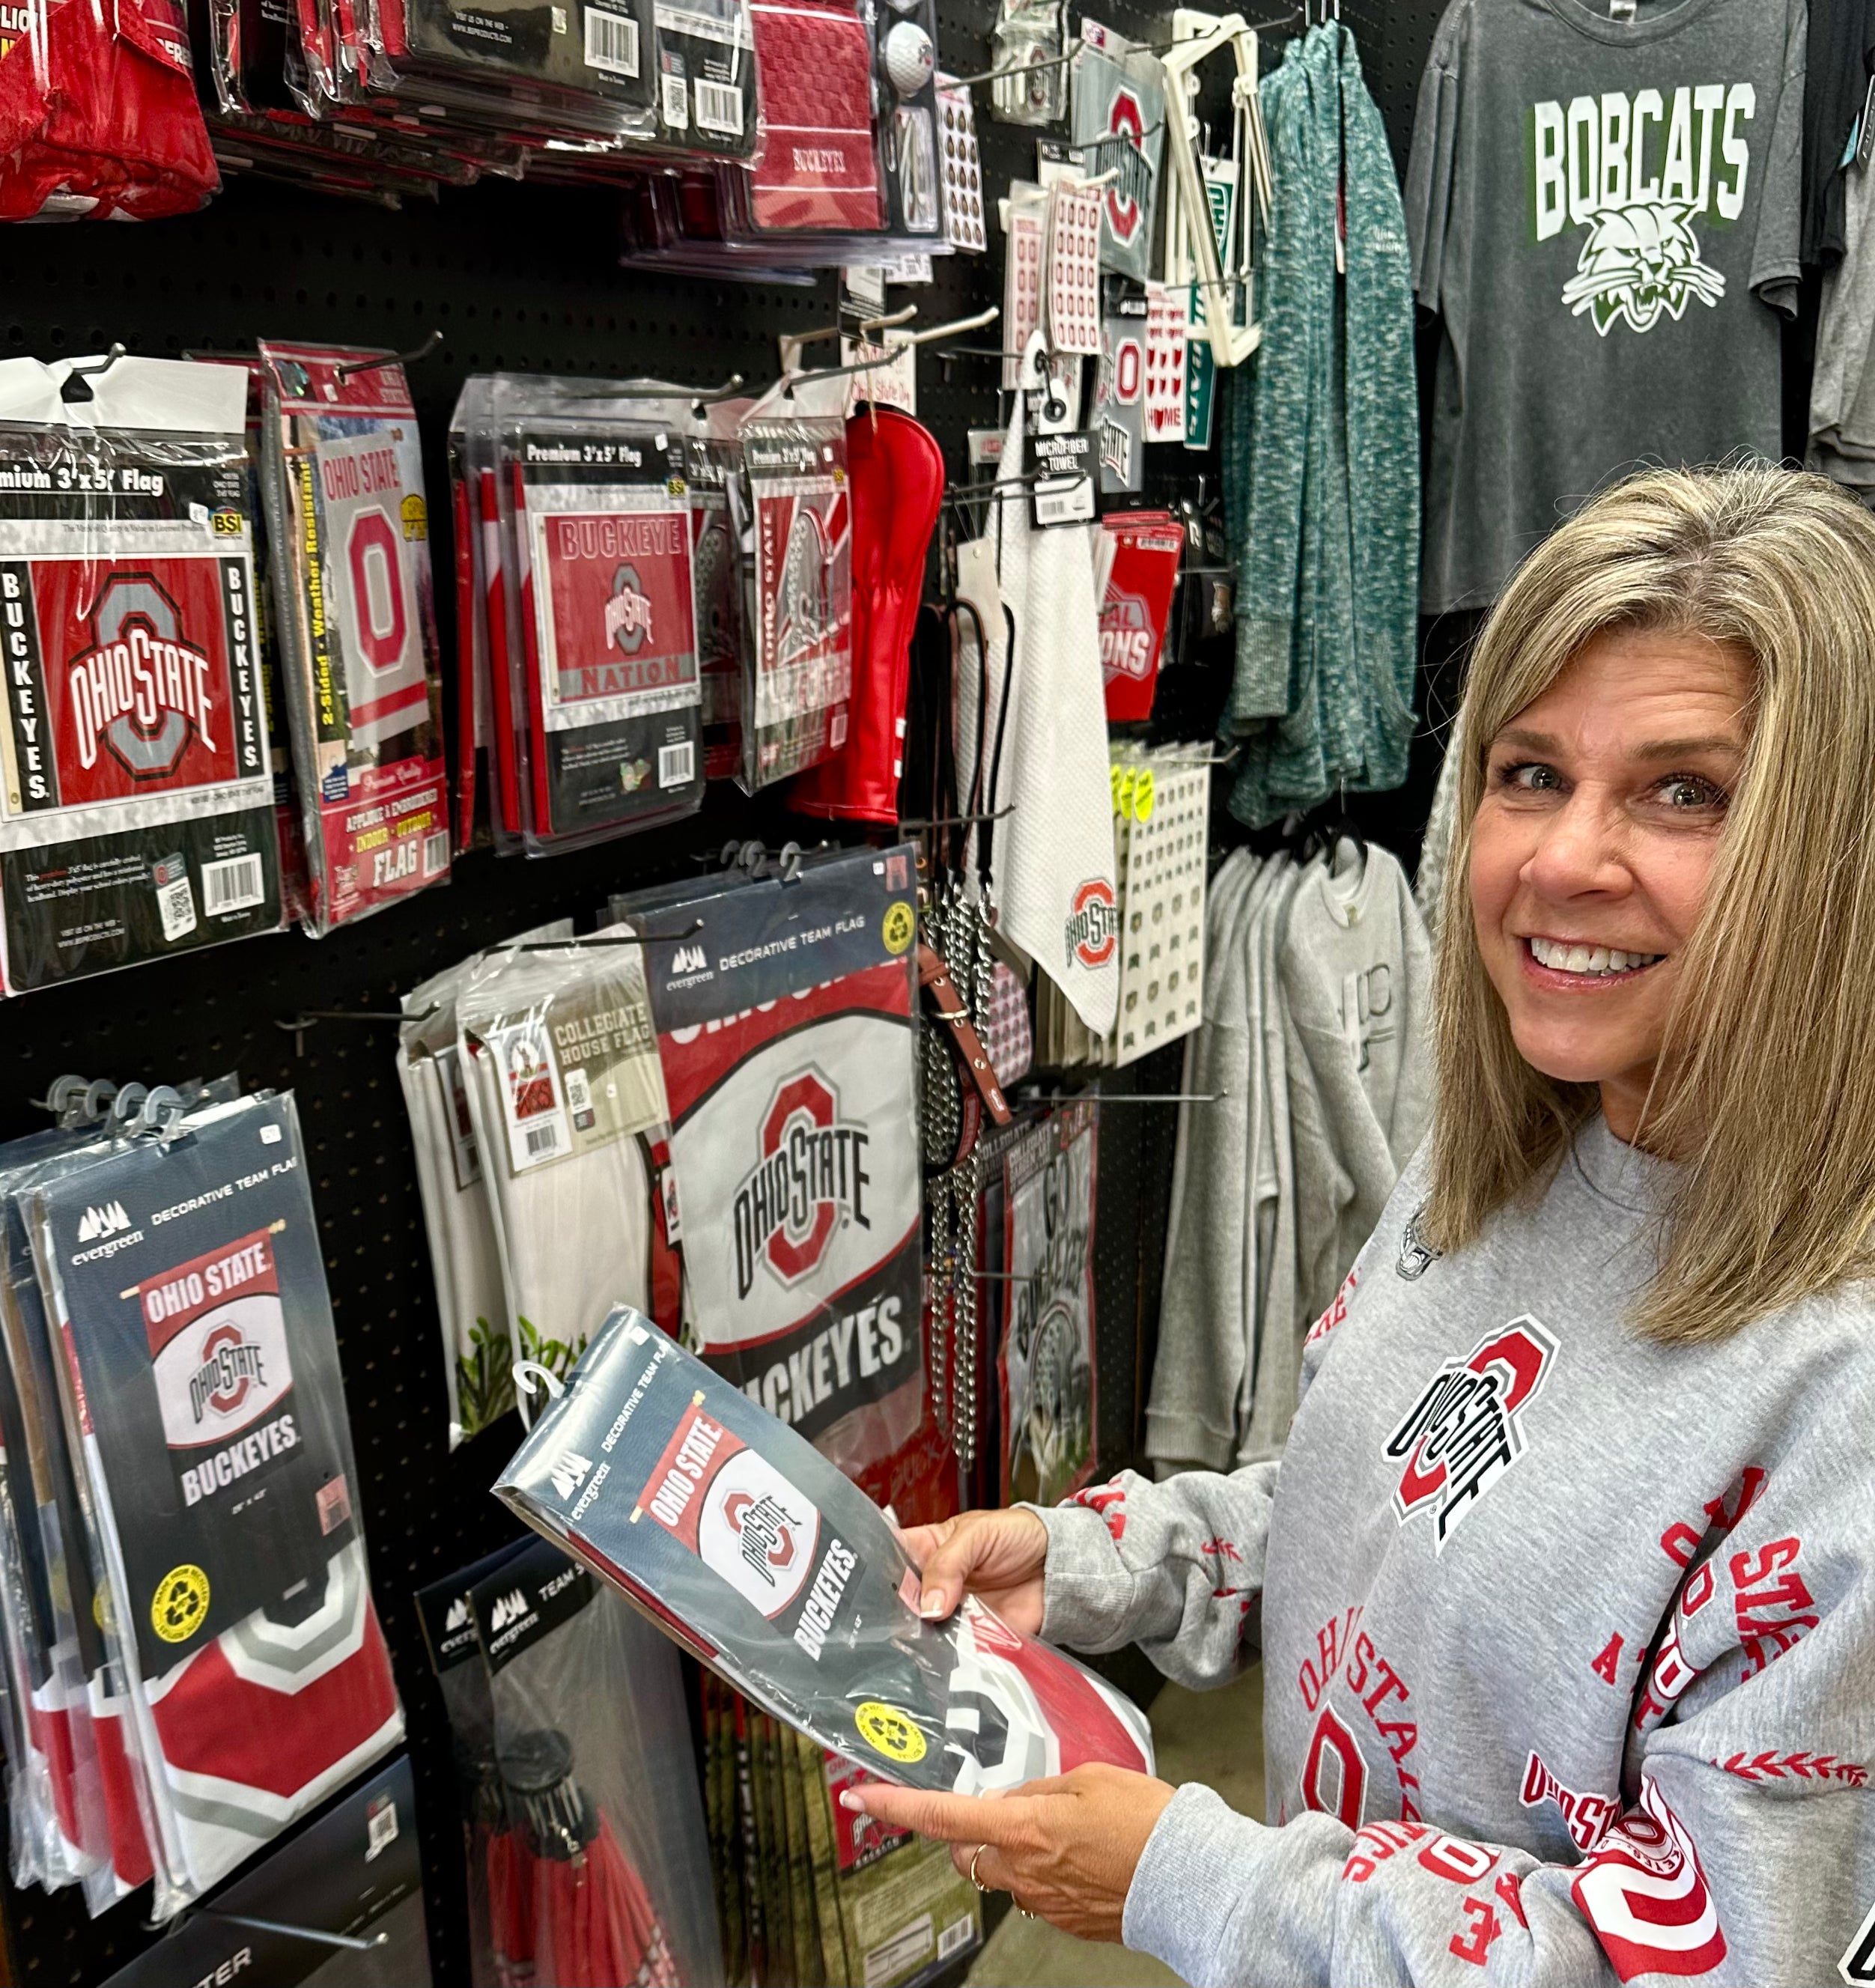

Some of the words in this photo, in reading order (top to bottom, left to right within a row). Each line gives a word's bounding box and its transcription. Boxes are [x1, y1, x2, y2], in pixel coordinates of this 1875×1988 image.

[792, 148, 846, 173] BUCKEYES
[1534, 82, 1756, 241] BOBCATS
[526, 443, 581, 462] Premium
[583, 445, 616, 463] 3'x5'
[619, 446, 642, 468] Flag
[1035, 436, 1090, 458] MICROFIBER
[1049, 455, 1079, 471] TOWEL
[122, 469, 164, 496] Flag
[322, 454, 359, 502] OHIO
[360, 449, 401, 494] STATE
[213, 514, 243, 533] BSI
[300, 462, 319, 555] Resistant
[559, 518, 681, 561] BUCKEYE
[308, 559, 326, 638] Weather
[1, 573, 47, 800] BUCKEYES
[227, 567, 258, 768] BUCKEYES
[320, 654, 334, 726] 2-Sided
[582, 656, 680, 695] NATION
[372, 839, 418, 888] FLAG
[719, 936, 798, 972] DECORATIVE
[800, 927, 833, 946] TEAM
[835, 915, 866, 936] FLAG
[666, 970, 714, 991] evergreen
[553, 1002, 648, 1047] COLLEGIATE
[561, 1036, 610, 1066] HOUSE
[615, 1024, 651, 1049] FLAG
[979, 1119, 1031, 1158] OLLEGIATE
[151, 1183, 234, 1226] DECORATIVE
[234, 1169, 270, 1191] TEAM
[734, 1150, 787, 1301] OHIO
[789, 1125, 872, 1232] STATE
[71, 1229, 145, 1266] evergreen
[145, 1265, 206, 1325] OHIO
[204, 1242, 270, 1299] STATE
[737, 1295, 903, 1425] CKEYES
[600, 1386, 645, 1453] DECORATIVE
[637, 1360, 660, 1388] TEAM
[180, 1413, 299, 1508] BUCKEYES
[648, 1465, 690, 1528] OHIO
[681, 1415, 723, 1477] STATE
[569, 1460, 611, 1523] evergreen
[537, 1567, 576, 1602] TEAM
[792, 1537, 858, 1662] BUCKEYES
